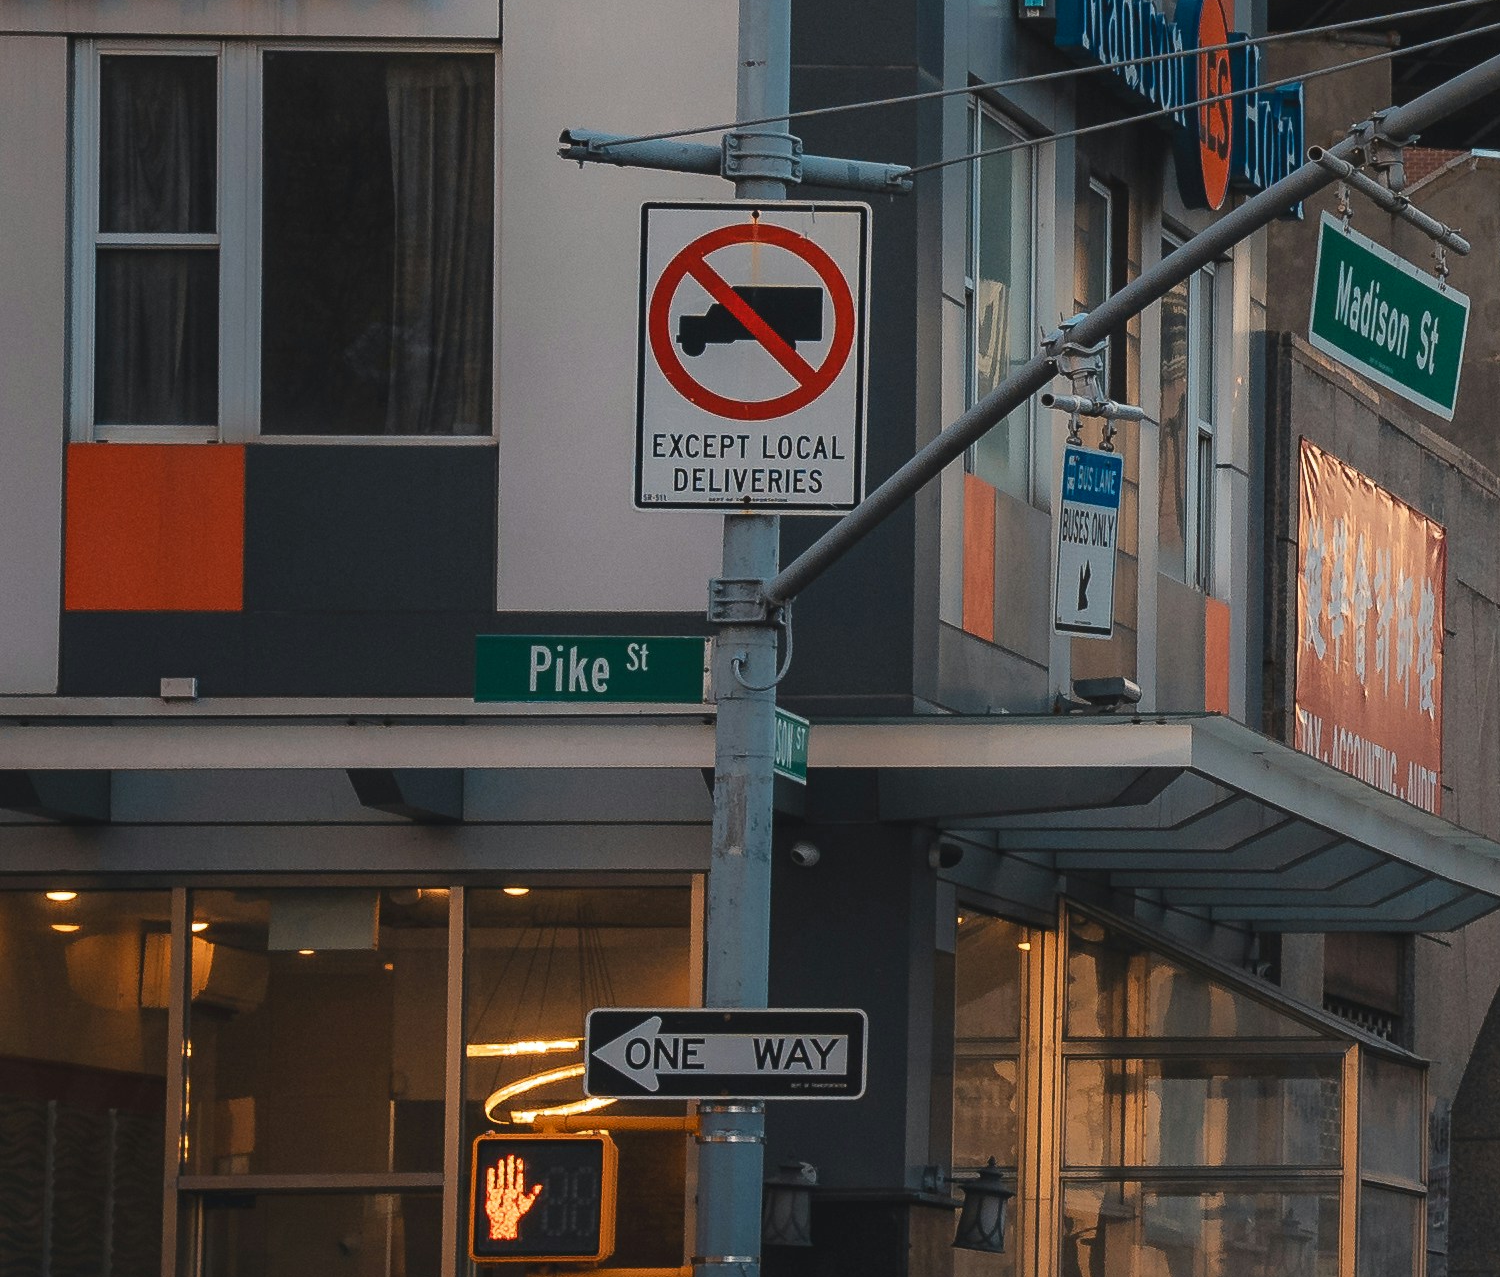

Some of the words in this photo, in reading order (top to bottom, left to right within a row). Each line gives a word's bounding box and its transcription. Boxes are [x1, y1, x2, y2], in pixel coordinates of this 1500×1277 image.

[1335, 261, 1410, 359] Madison
[1416, 310, 1439, 375] St
[652, 433, 750, 459] EXCEPT
[762, 434, 846, 460] LOCAL
[673, 468, 823, 493] DELIVERIES
[1077, 465, 1093, 491] BUS
[1094, 468, 1117, 496] LANE
[1062, 508, 1090, 545] BUSES
[1091, 511, 1115, 549] ONLY
[529, 645, 611, 693] Pike
[626, 642, 649, 671] St
[625, 1037, 705, 1070] ONE
[753, 1037, 840, 1070] WAY
